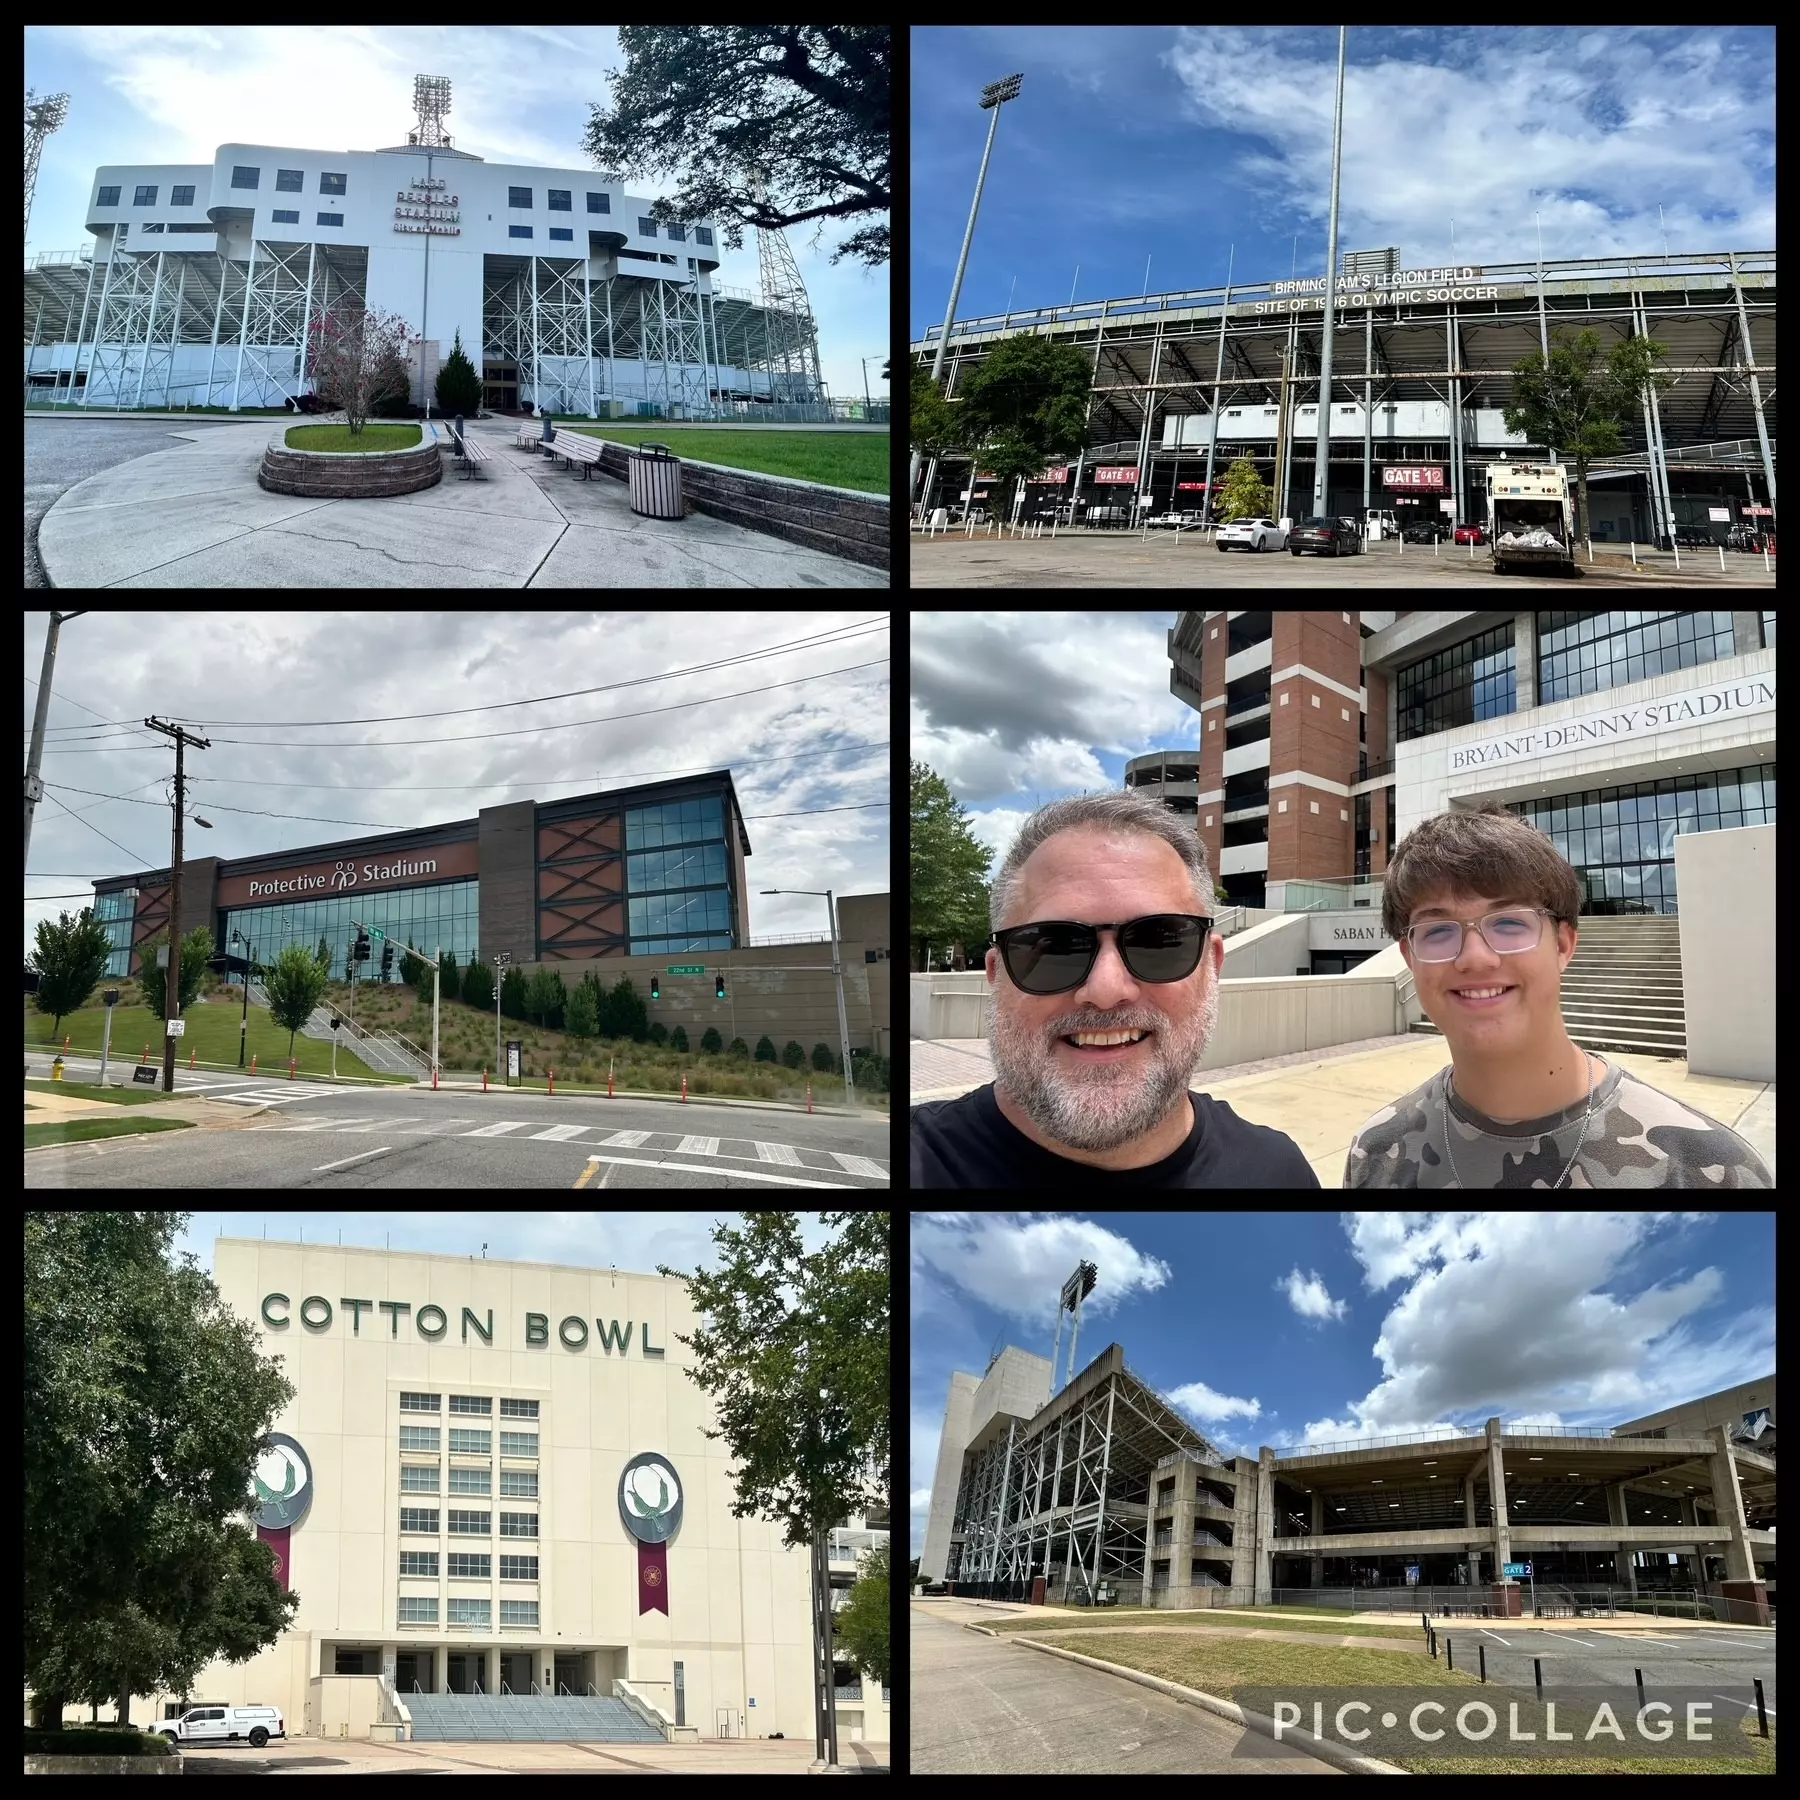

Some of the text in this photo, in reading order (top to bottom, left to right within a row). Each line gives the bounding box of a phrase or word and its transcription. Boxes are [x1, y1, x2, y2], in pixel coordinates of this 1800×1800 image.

[411, 177, 446, 190] LADD
[397, 192, 459, 207] PEEBLES
[395, 207, 461, 223] STADIUM
[393, 223, 413, 233] City
[430, 225, 460, 235] Mobile
[1374, 270, 1427, 286] LEGION
[1432, 267, 1473, 282] FIELD
[1255, 301, 1286, 313] SITE
[1290, 298, 1309, 311] OF
[1351, 290, 1421, 306] OLYMPIC
[1427, 286, 1498, 302] SOCCER
[1054, 471, 1063, 480] 10
[1100, 471, 1135, 480] GATE 11
[1385, 469, 1441, 483] GATE 12
[1452, 710, 1639, 769] BRYANT-DENNY
[250, 859, 437, 896] Protective Stadium
[1334, 927, 1375, 940] SABAN
[261, 1292, 665, 1354] COTTON BOWL
[1525, 1565, 1531, 1574] 2
